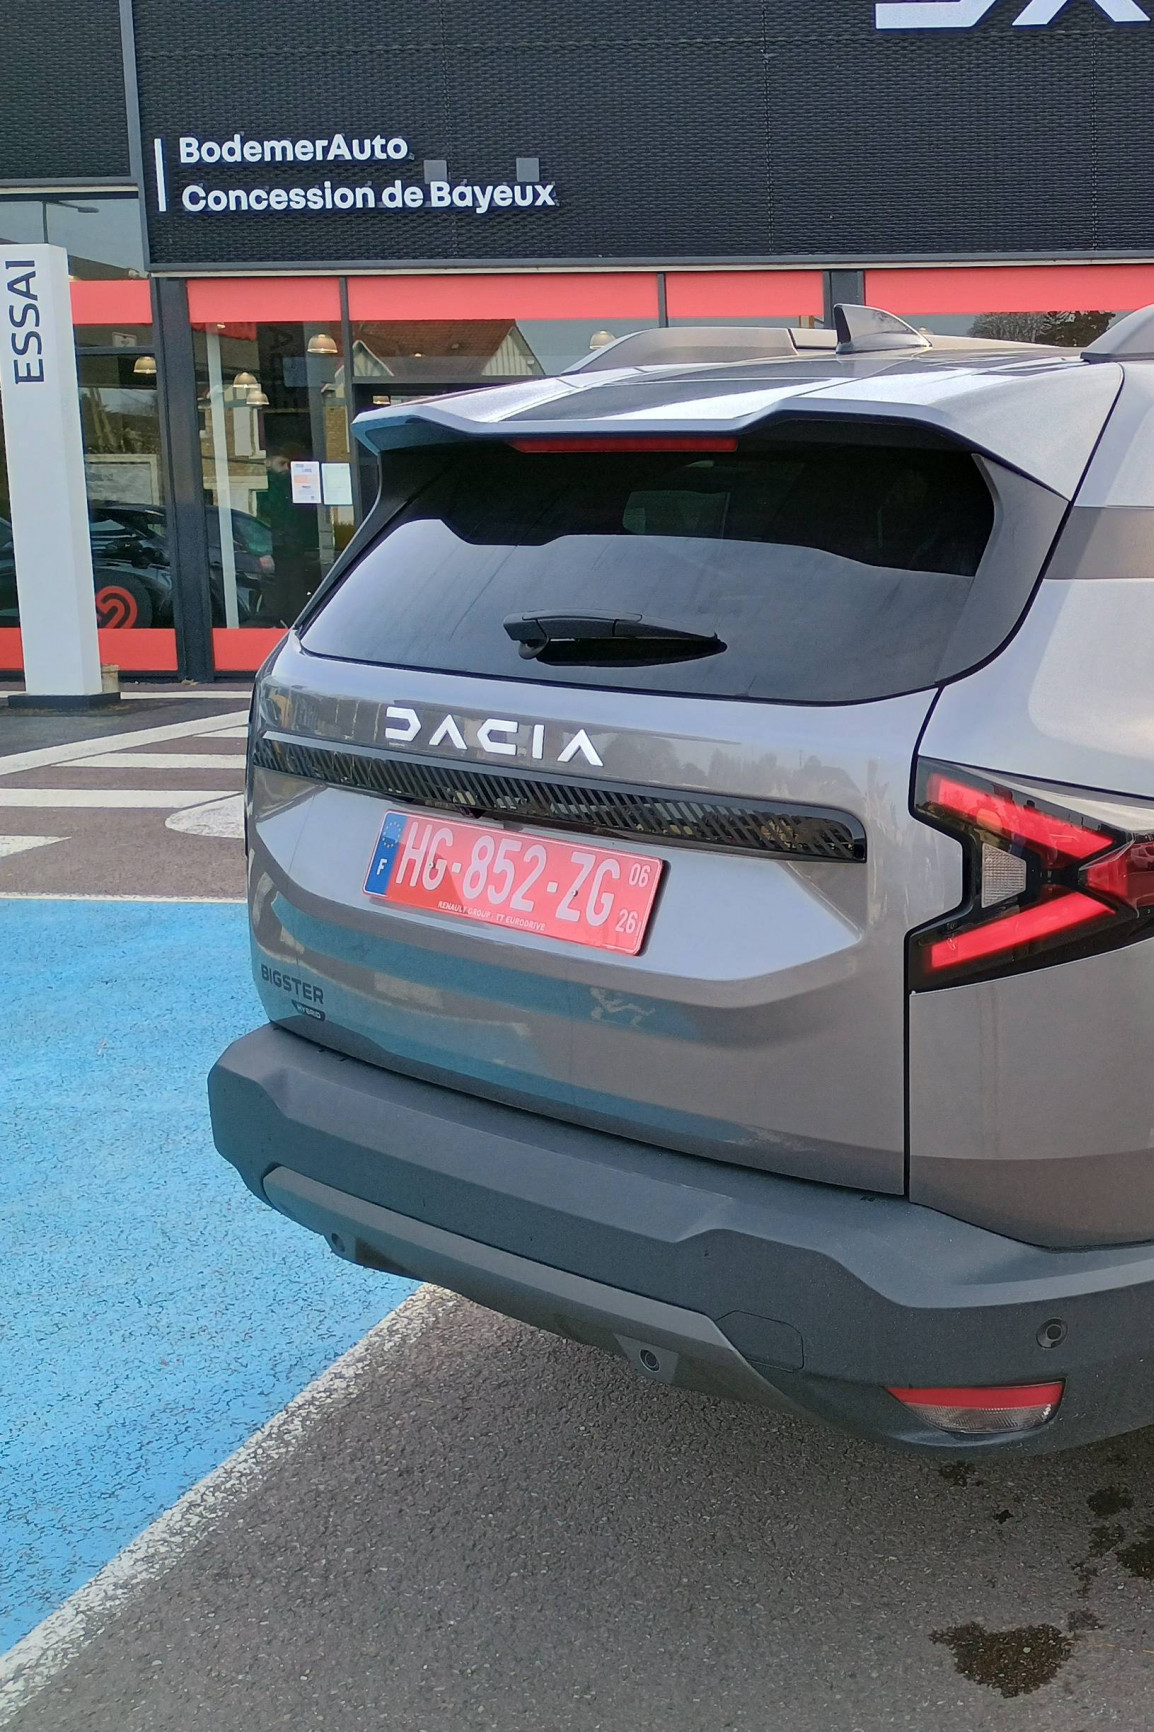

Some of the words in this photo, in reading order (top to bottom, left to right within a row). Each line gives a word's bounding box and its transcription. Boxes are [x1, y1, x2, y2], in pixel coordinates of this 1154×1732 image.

[179, 134, 409, 164] BodemerAuto
[181, 180, 375, 213] Concession
[381, 180, 424, 209] de
[430, 180, 556, 214] Bayeux
[5, 259, 45, 384] ESSAI
[384, 706, 604, 767] DACIA
[376, 858, 387, 876] F
[628, 863, 650, 887] 06
[615, 909, 638, 935] 26
[260, 963, 324, 1004] BIGSTER
